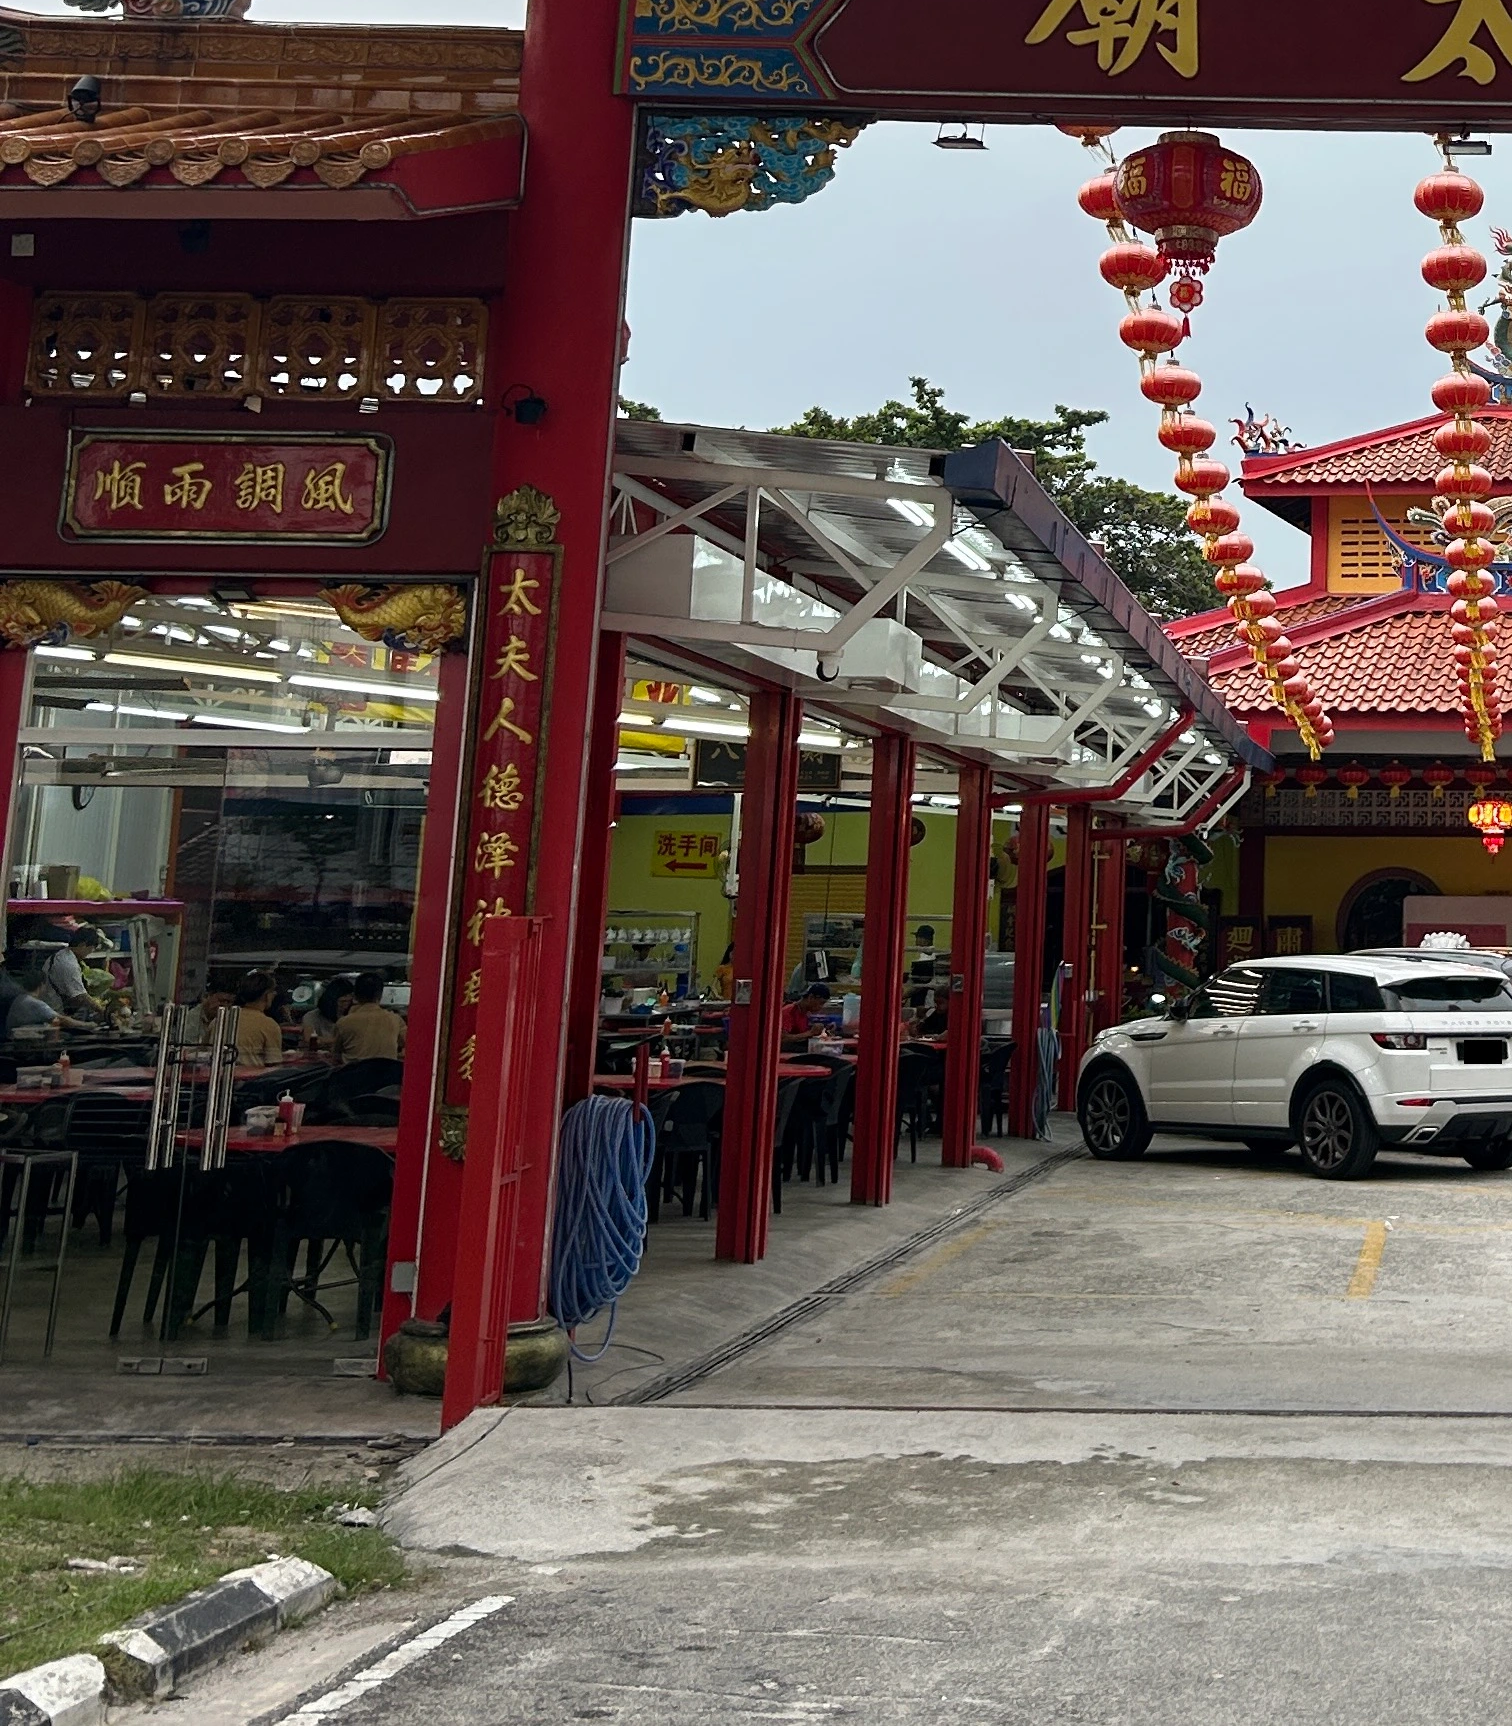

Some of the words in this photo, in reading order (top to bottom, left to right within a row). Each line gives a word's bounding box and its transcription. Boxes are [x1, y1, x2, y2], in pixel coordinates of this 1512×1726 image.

[1220, 159, 1252, 201] 福
[657, 834, 719, 857] 洗手间
